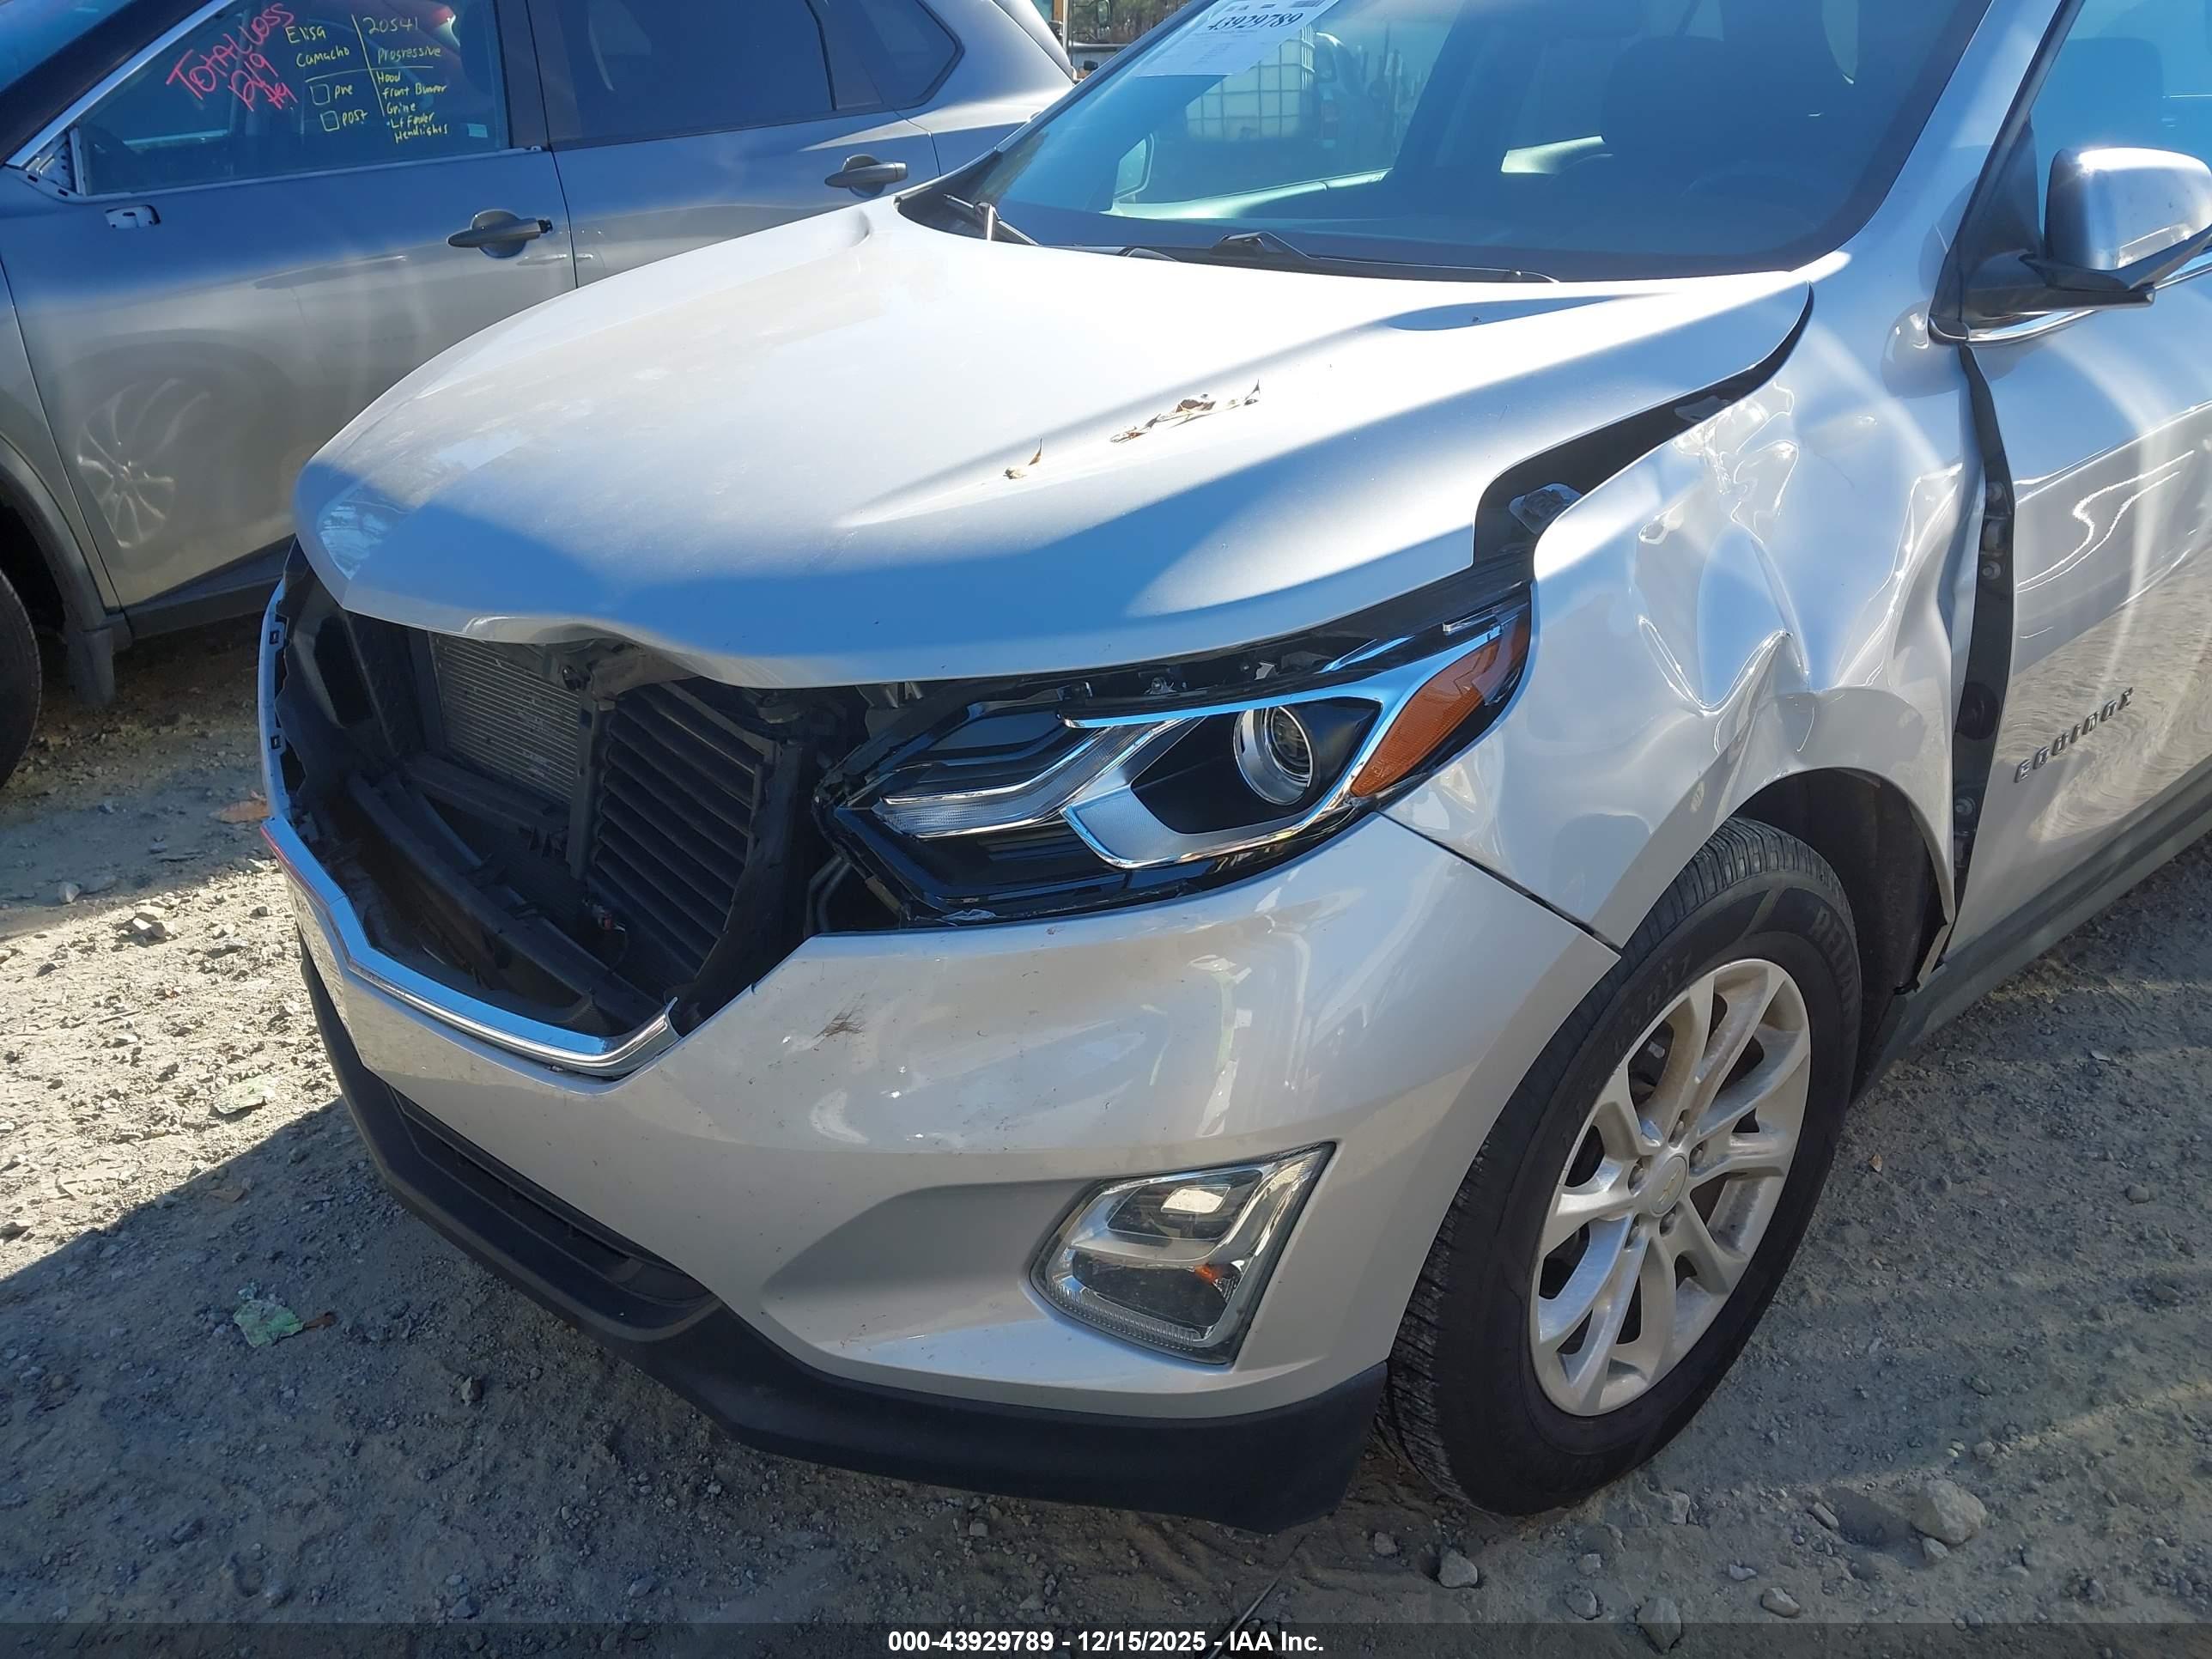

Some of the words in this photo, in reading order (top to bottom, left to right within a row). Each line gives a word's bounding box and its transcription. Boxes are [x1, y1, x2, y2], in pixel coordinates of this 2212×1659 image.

[362, 16, 419, 34] 20541
[1207, 12, 1304, 31] 43929789
[2014, 686, 2134, 783] EQUINOX
